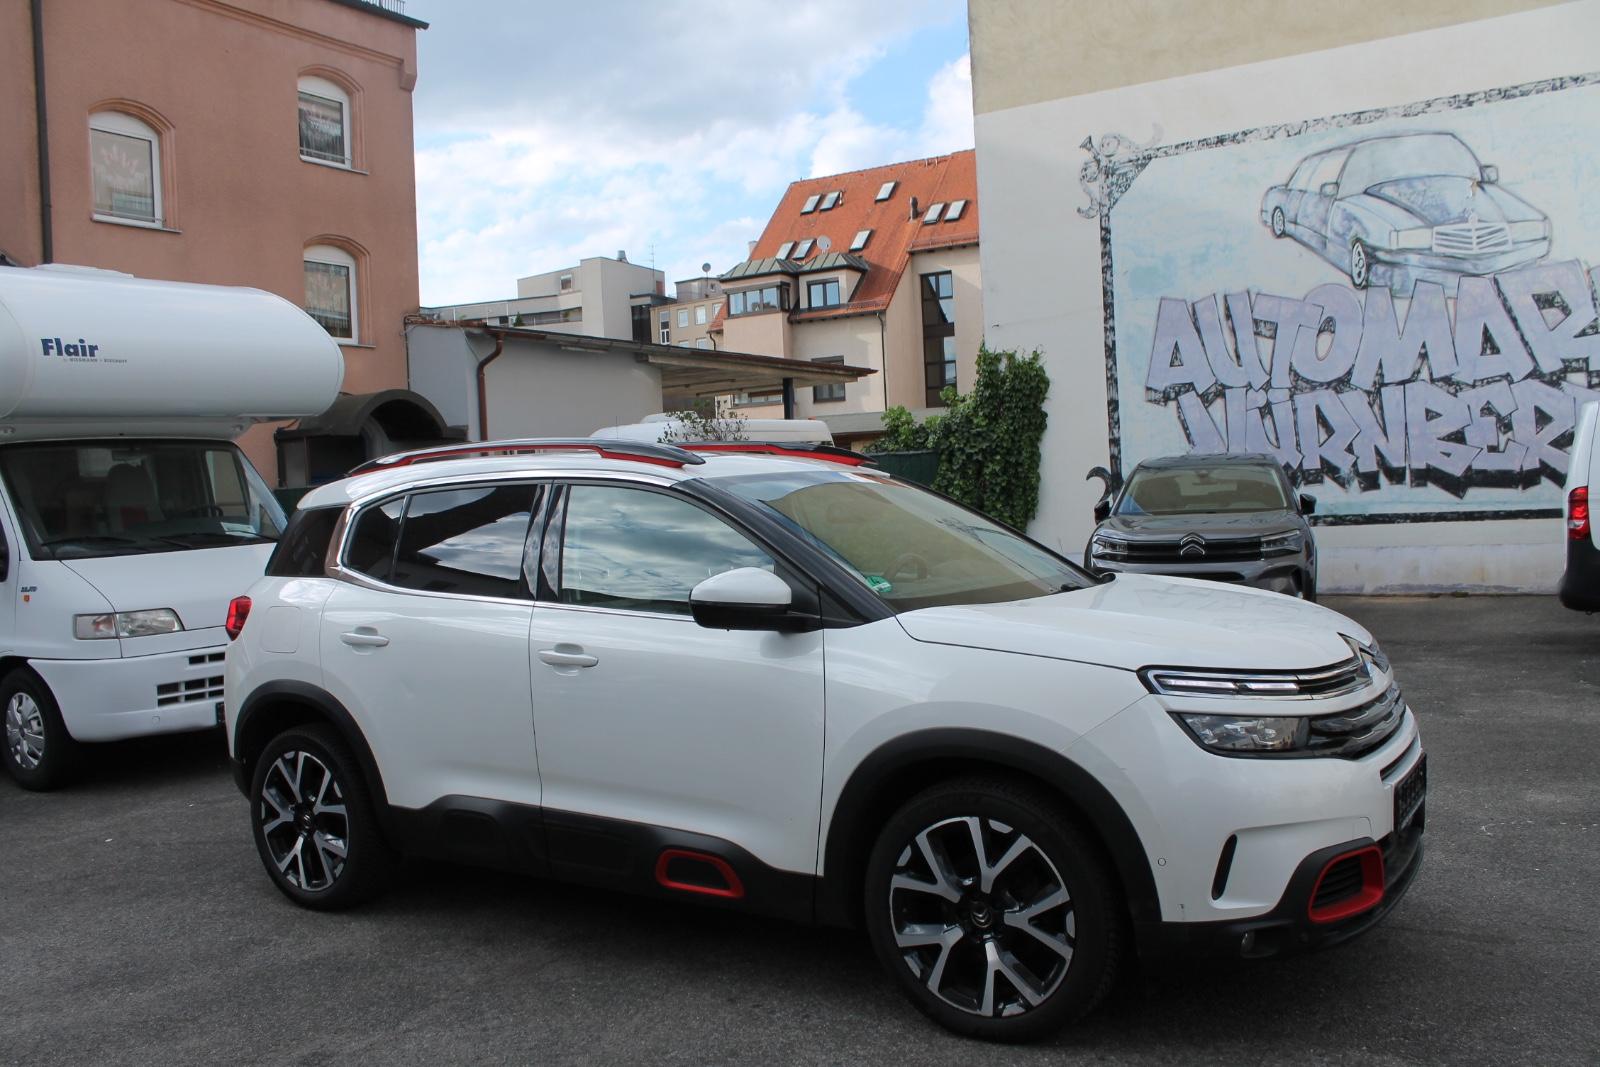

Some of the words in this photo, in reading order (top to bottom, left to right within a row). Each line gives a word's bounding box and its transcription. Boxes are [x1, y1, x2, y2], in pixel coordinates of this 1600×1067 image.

[40, 337, 99, 358] Flair
[1146, 258, 1600, 394] AUTOMAR
[1175, 378, 1600, 478] NÜRNBER
